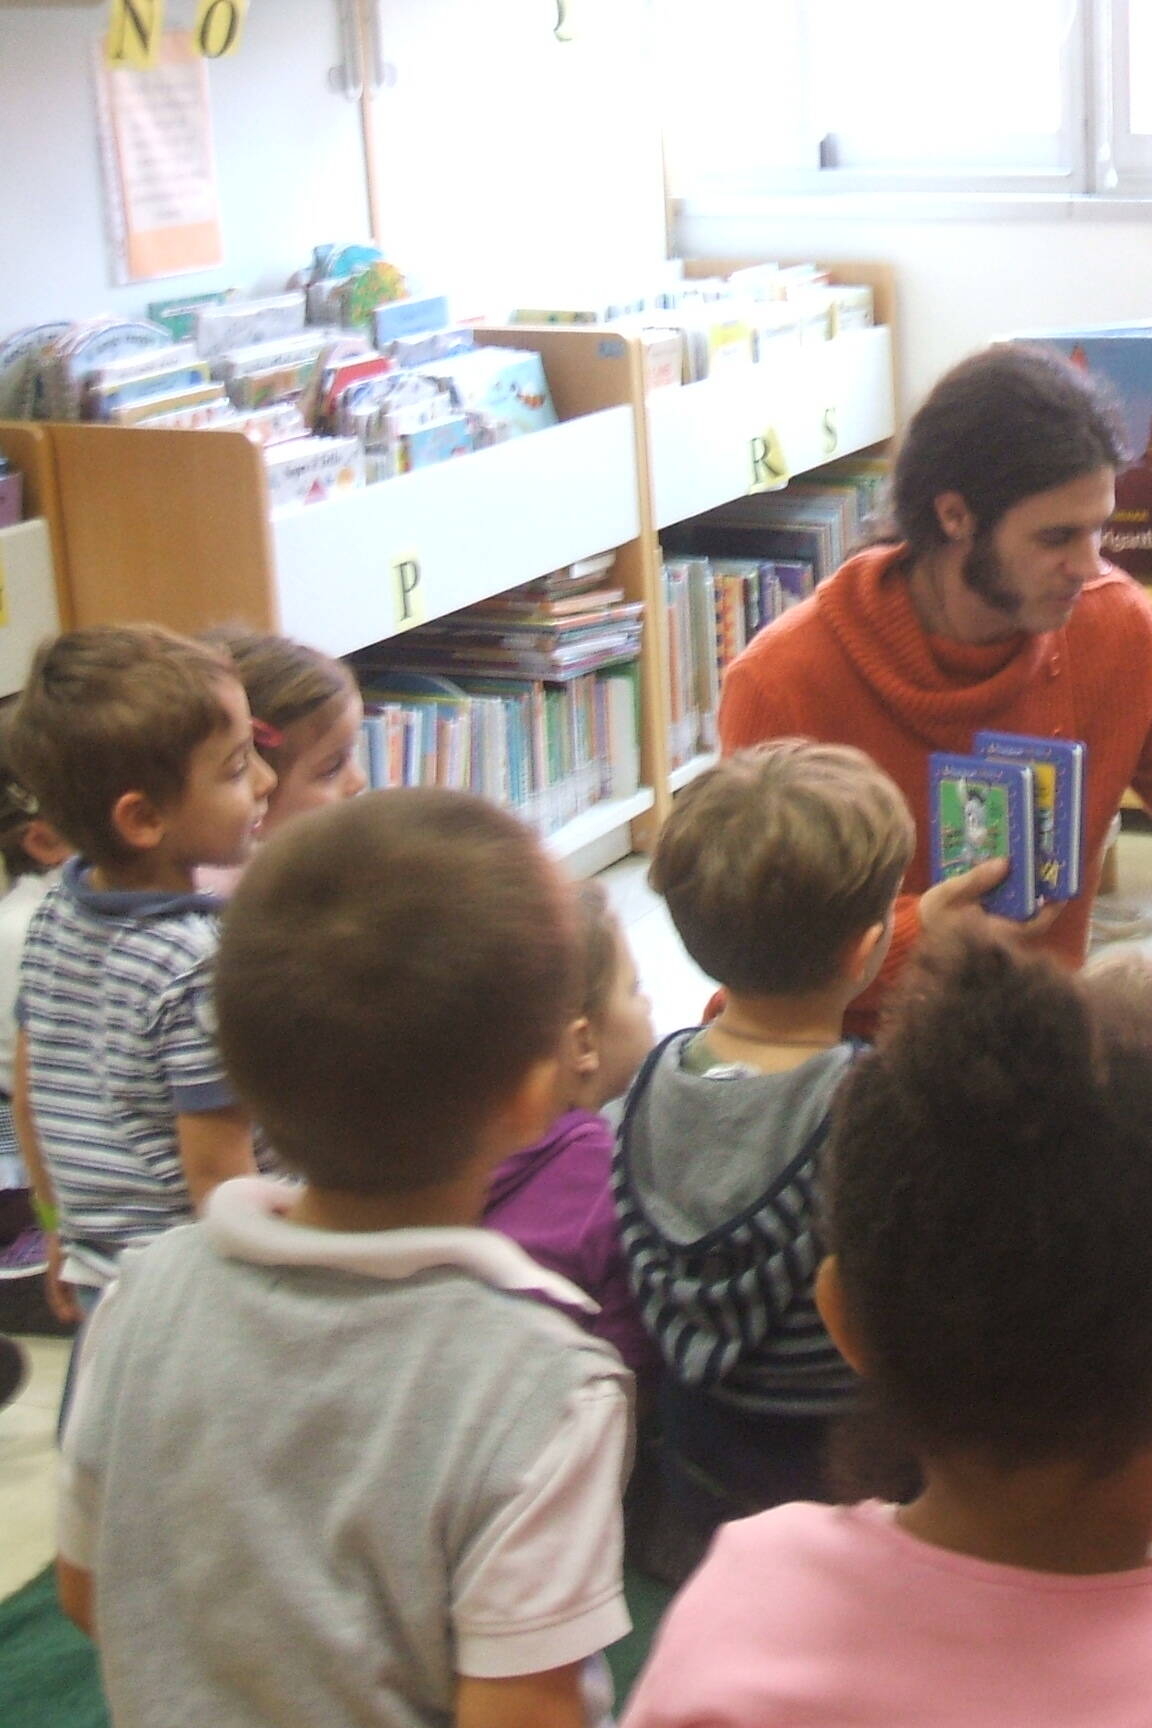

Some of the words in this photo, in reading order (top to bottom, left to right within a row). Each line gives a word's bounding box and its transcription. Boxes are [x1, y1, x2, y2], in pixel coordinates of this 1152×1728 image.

[111, 0, 155, 60] N
[200, 0, 237, 59] O
[823, 406, 838, 455] S
[750, 437, 784, 485] R
[392, 560, 420, 622] P
